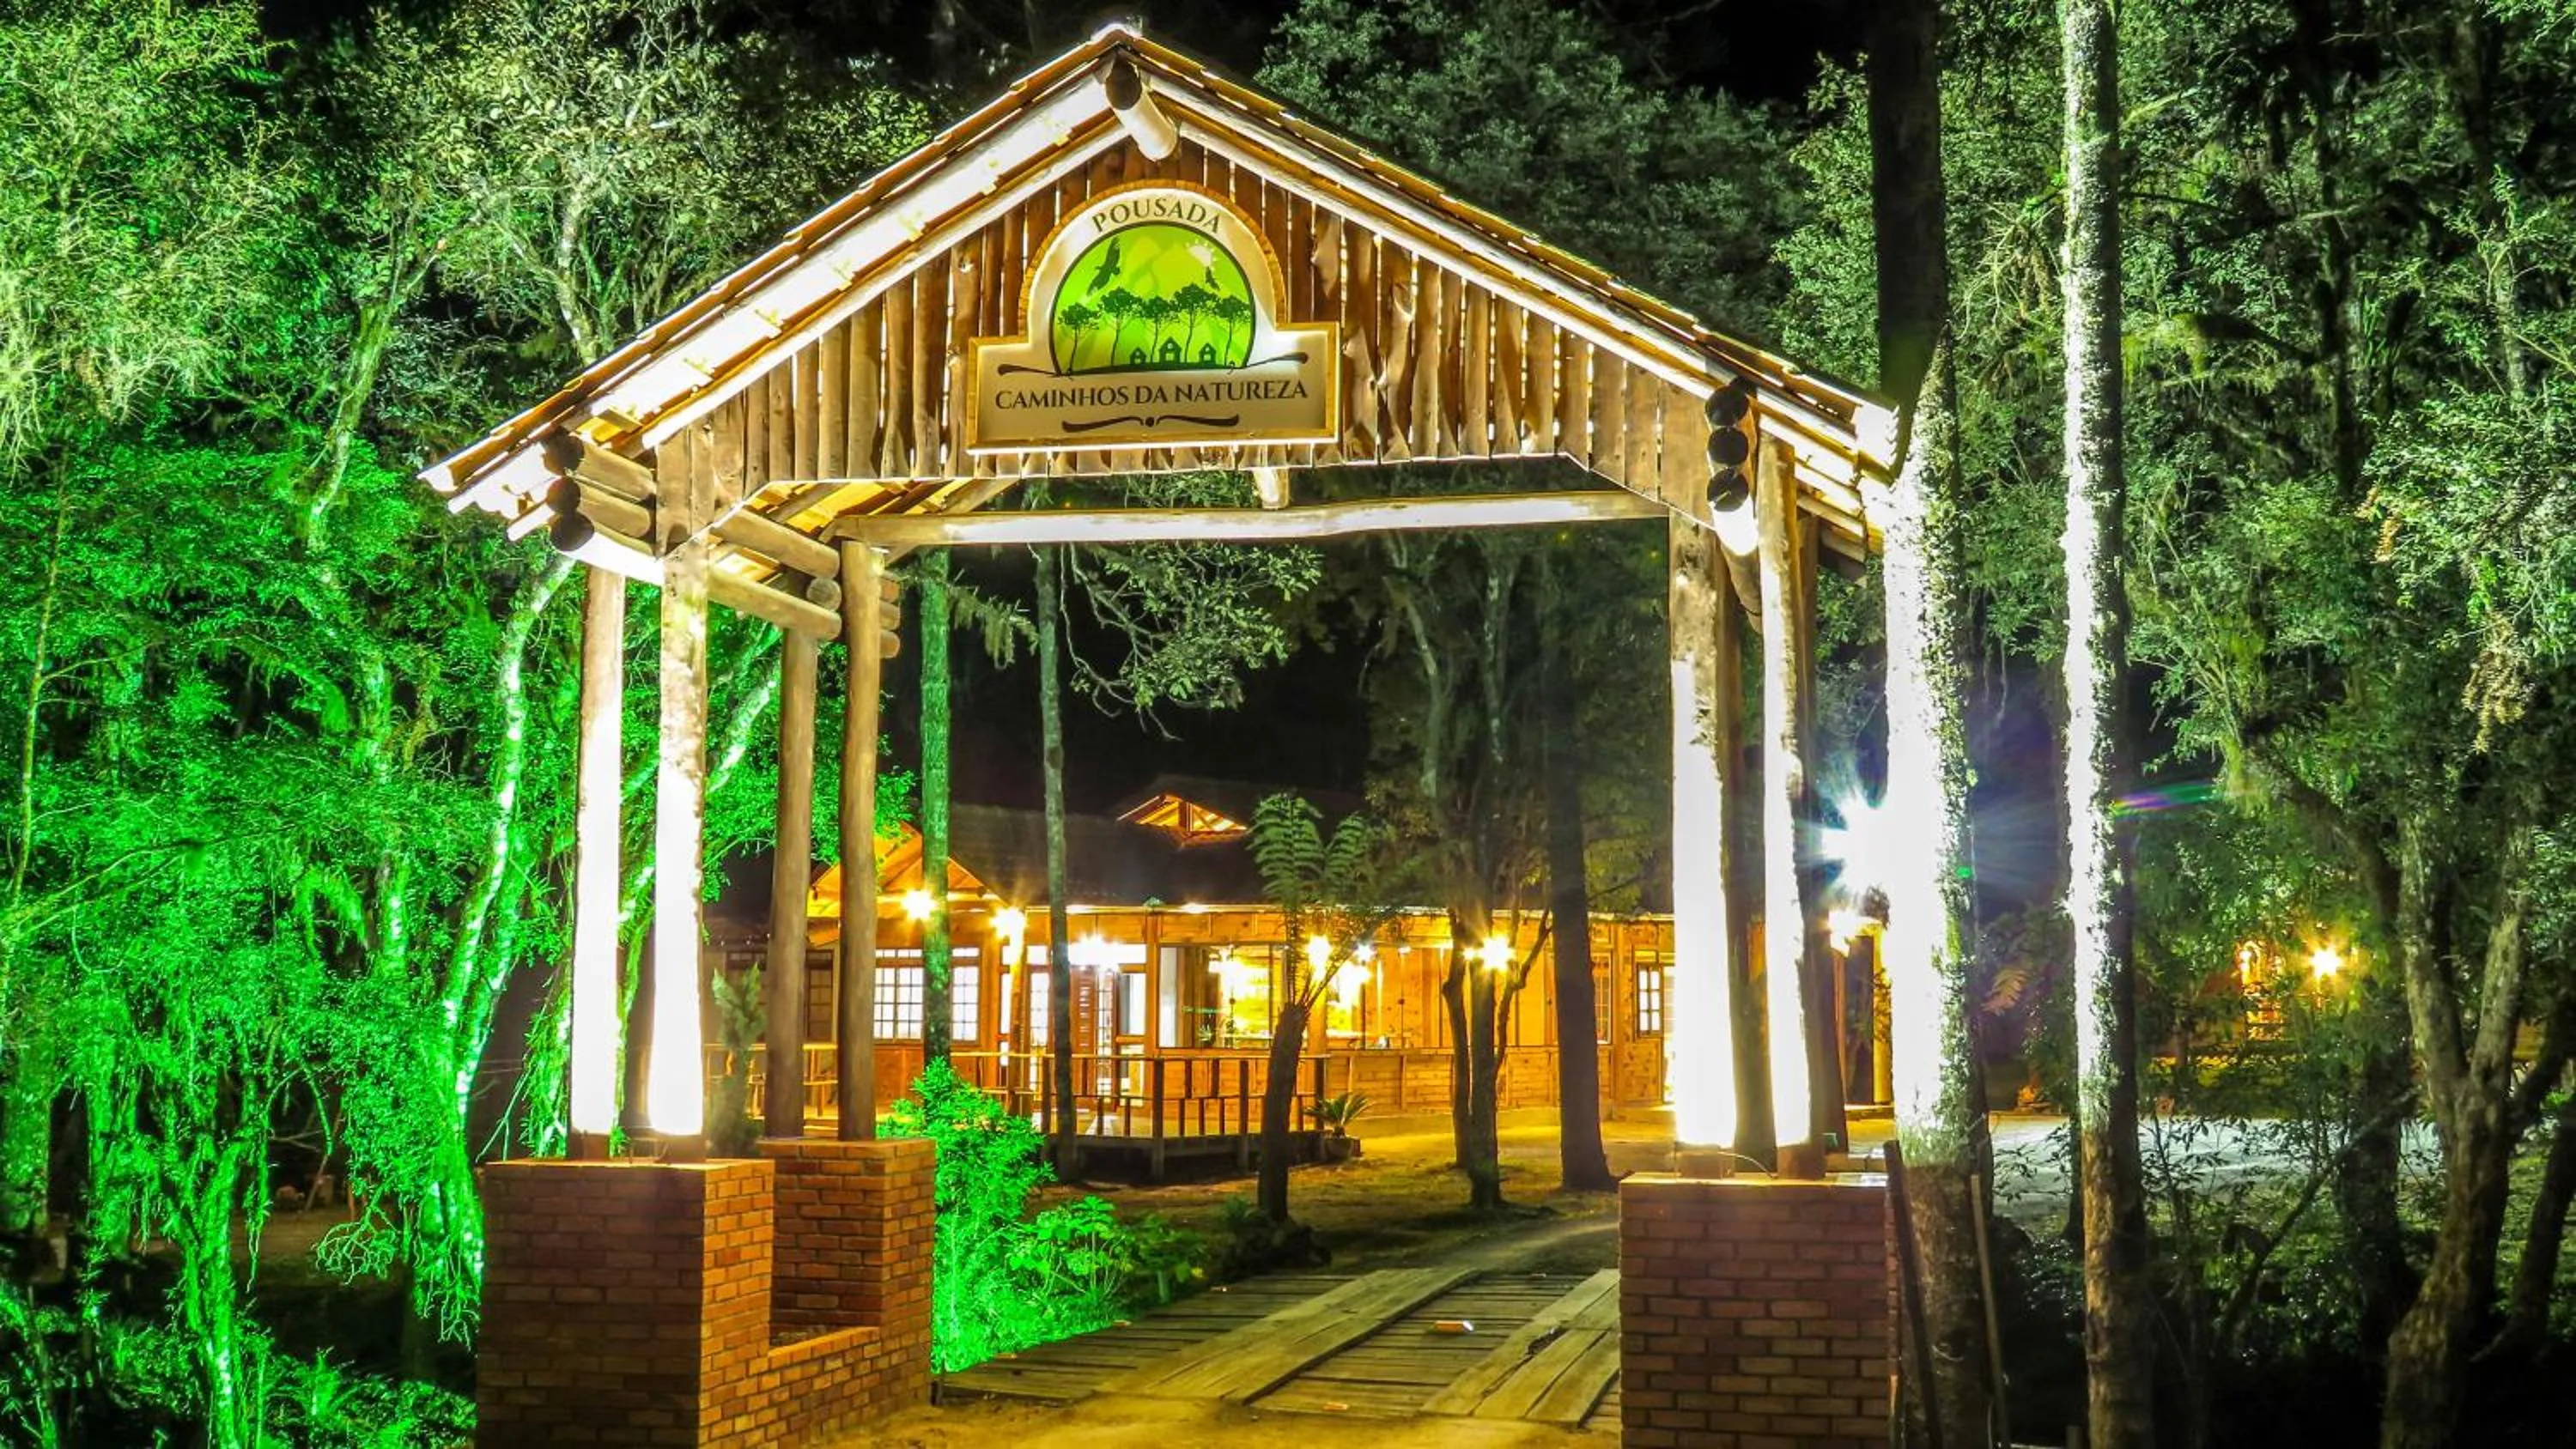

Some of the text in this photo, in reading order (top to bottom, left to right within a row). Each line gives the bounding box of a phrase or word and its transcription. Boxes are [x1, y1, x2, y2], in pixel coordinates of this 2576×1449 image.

[1091, 197, 1221, 233] POUSADA
[995, 379, 1309, 409] CAMINHOS DA NATUREZA
